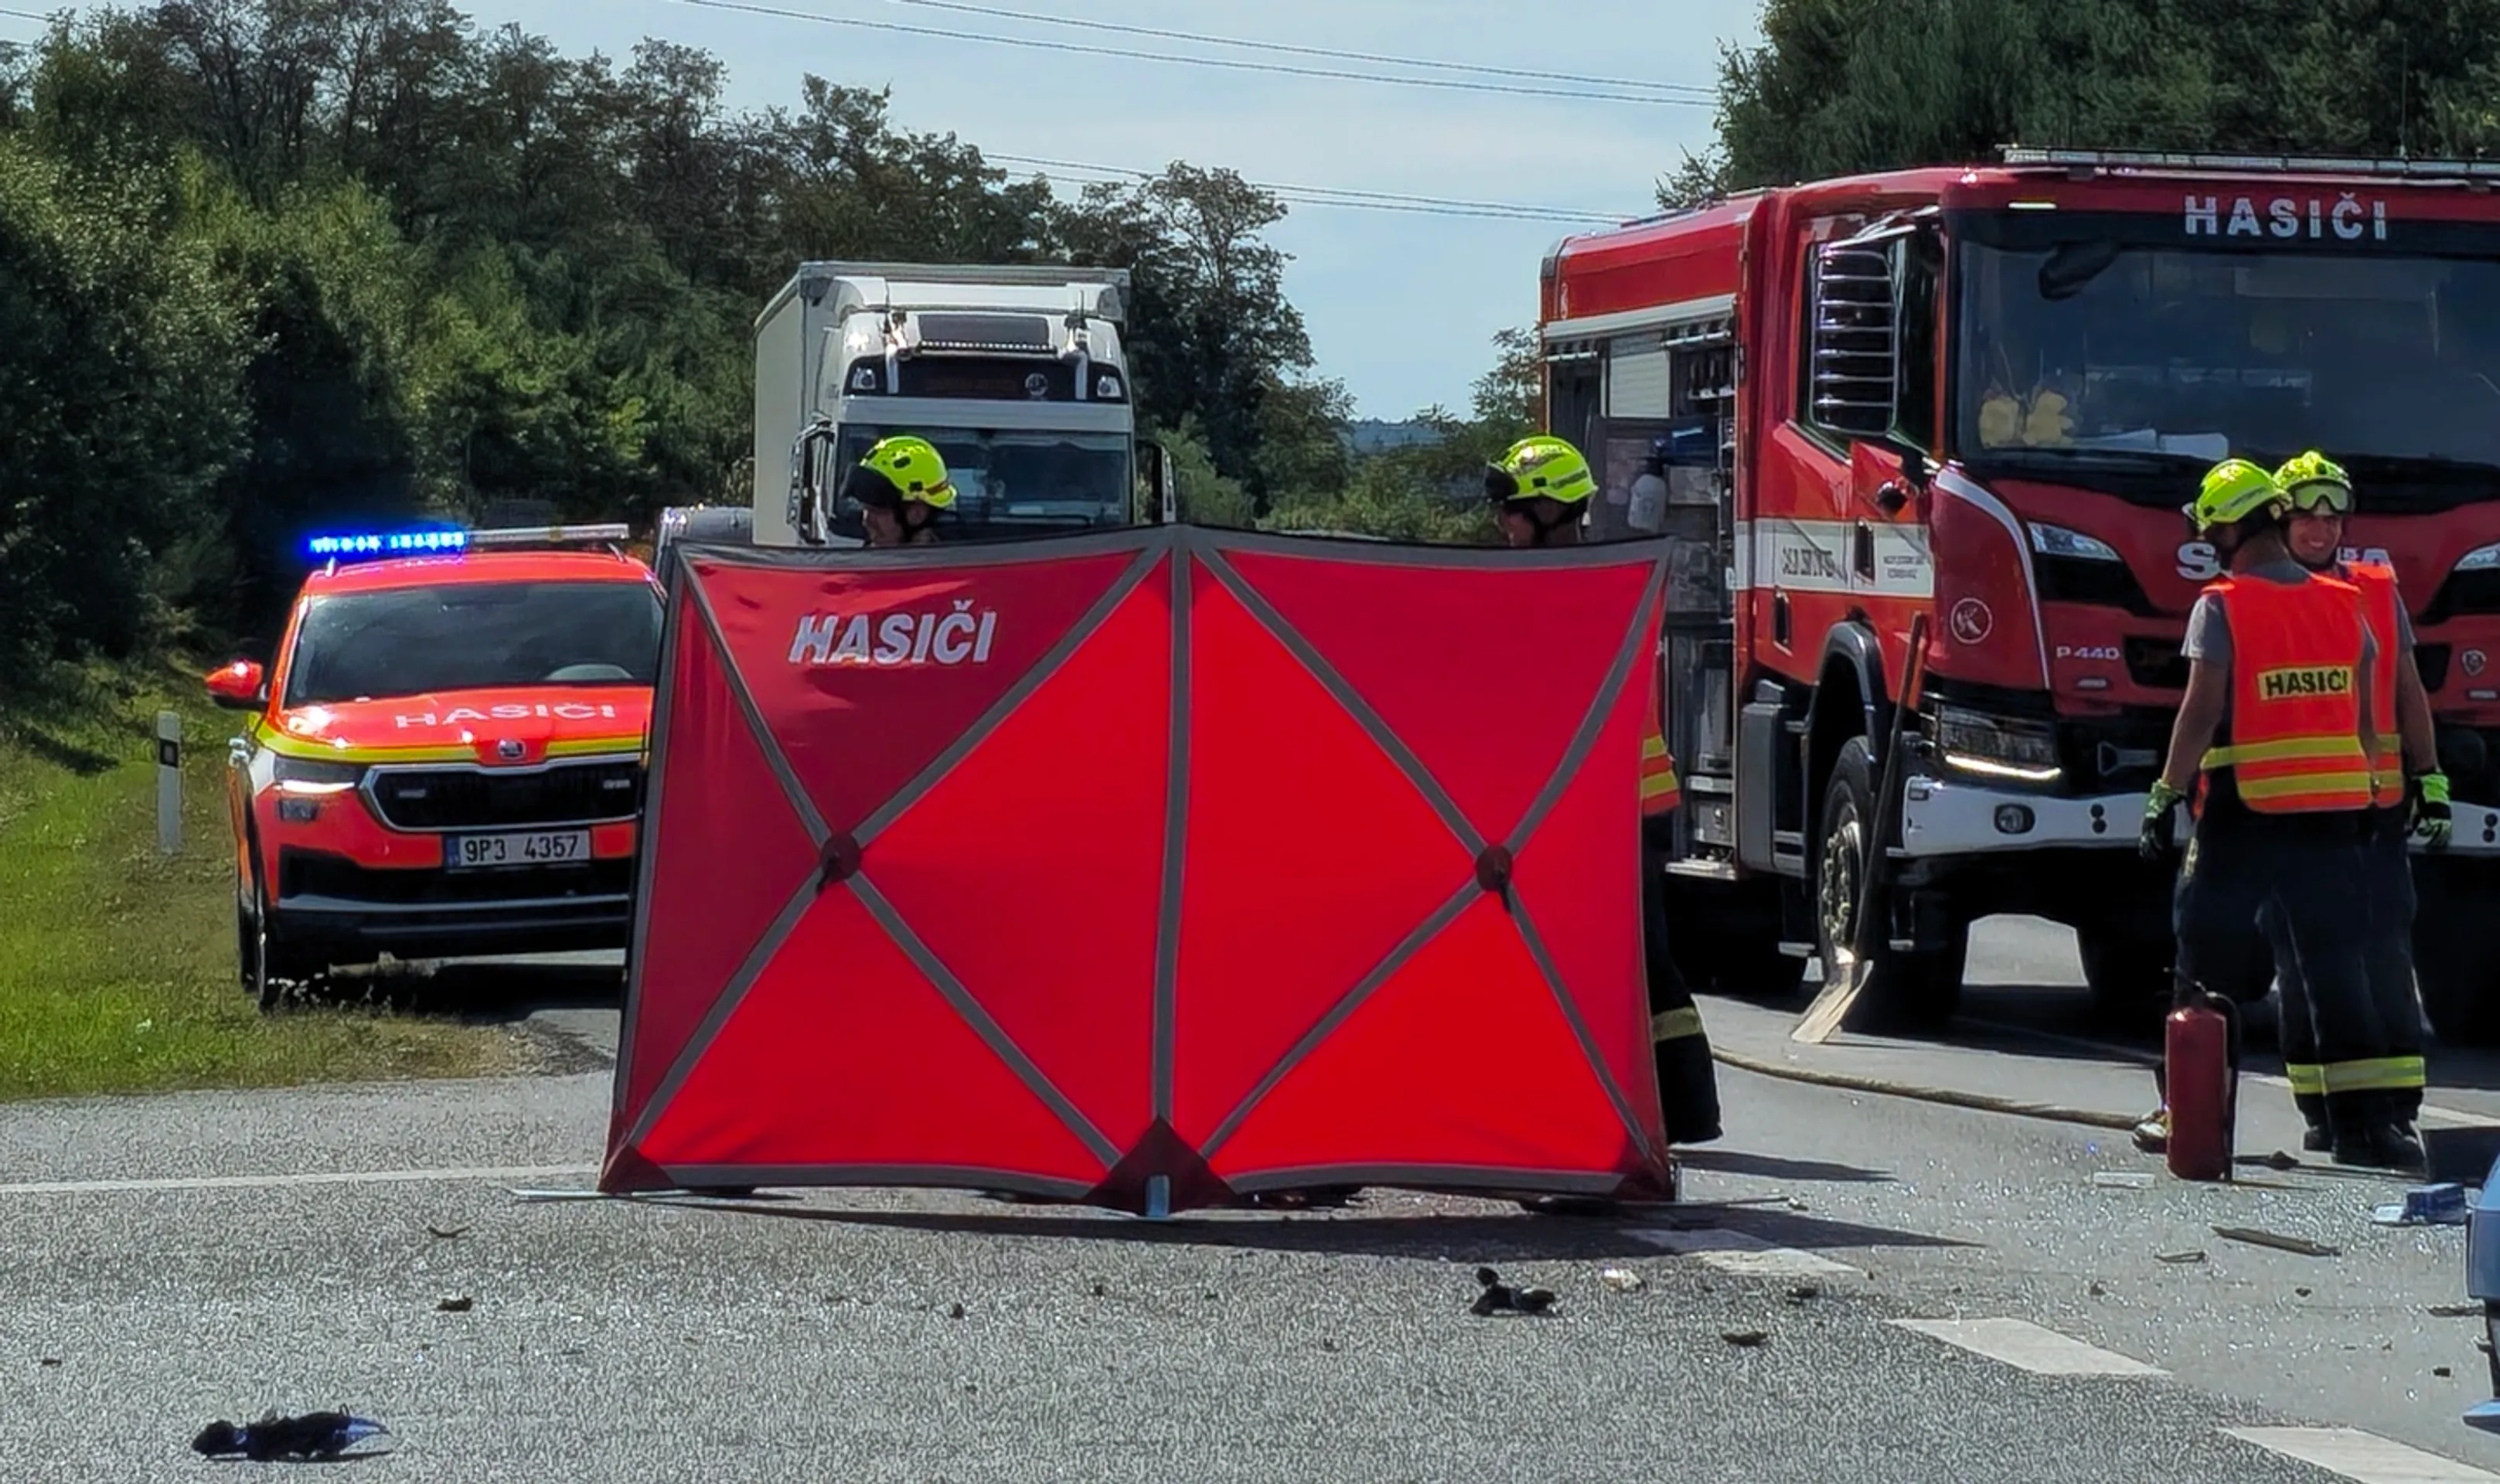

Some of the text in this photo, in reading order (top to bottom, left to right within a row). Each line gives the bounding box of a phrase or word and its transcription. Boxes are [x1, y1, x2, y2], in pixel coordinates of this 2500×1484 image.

[2185, 192, 2387, 240] HASIČI
[788, 599, 997, 665] HASIČI
[465, 835, 579, 863] 9P3 4357
